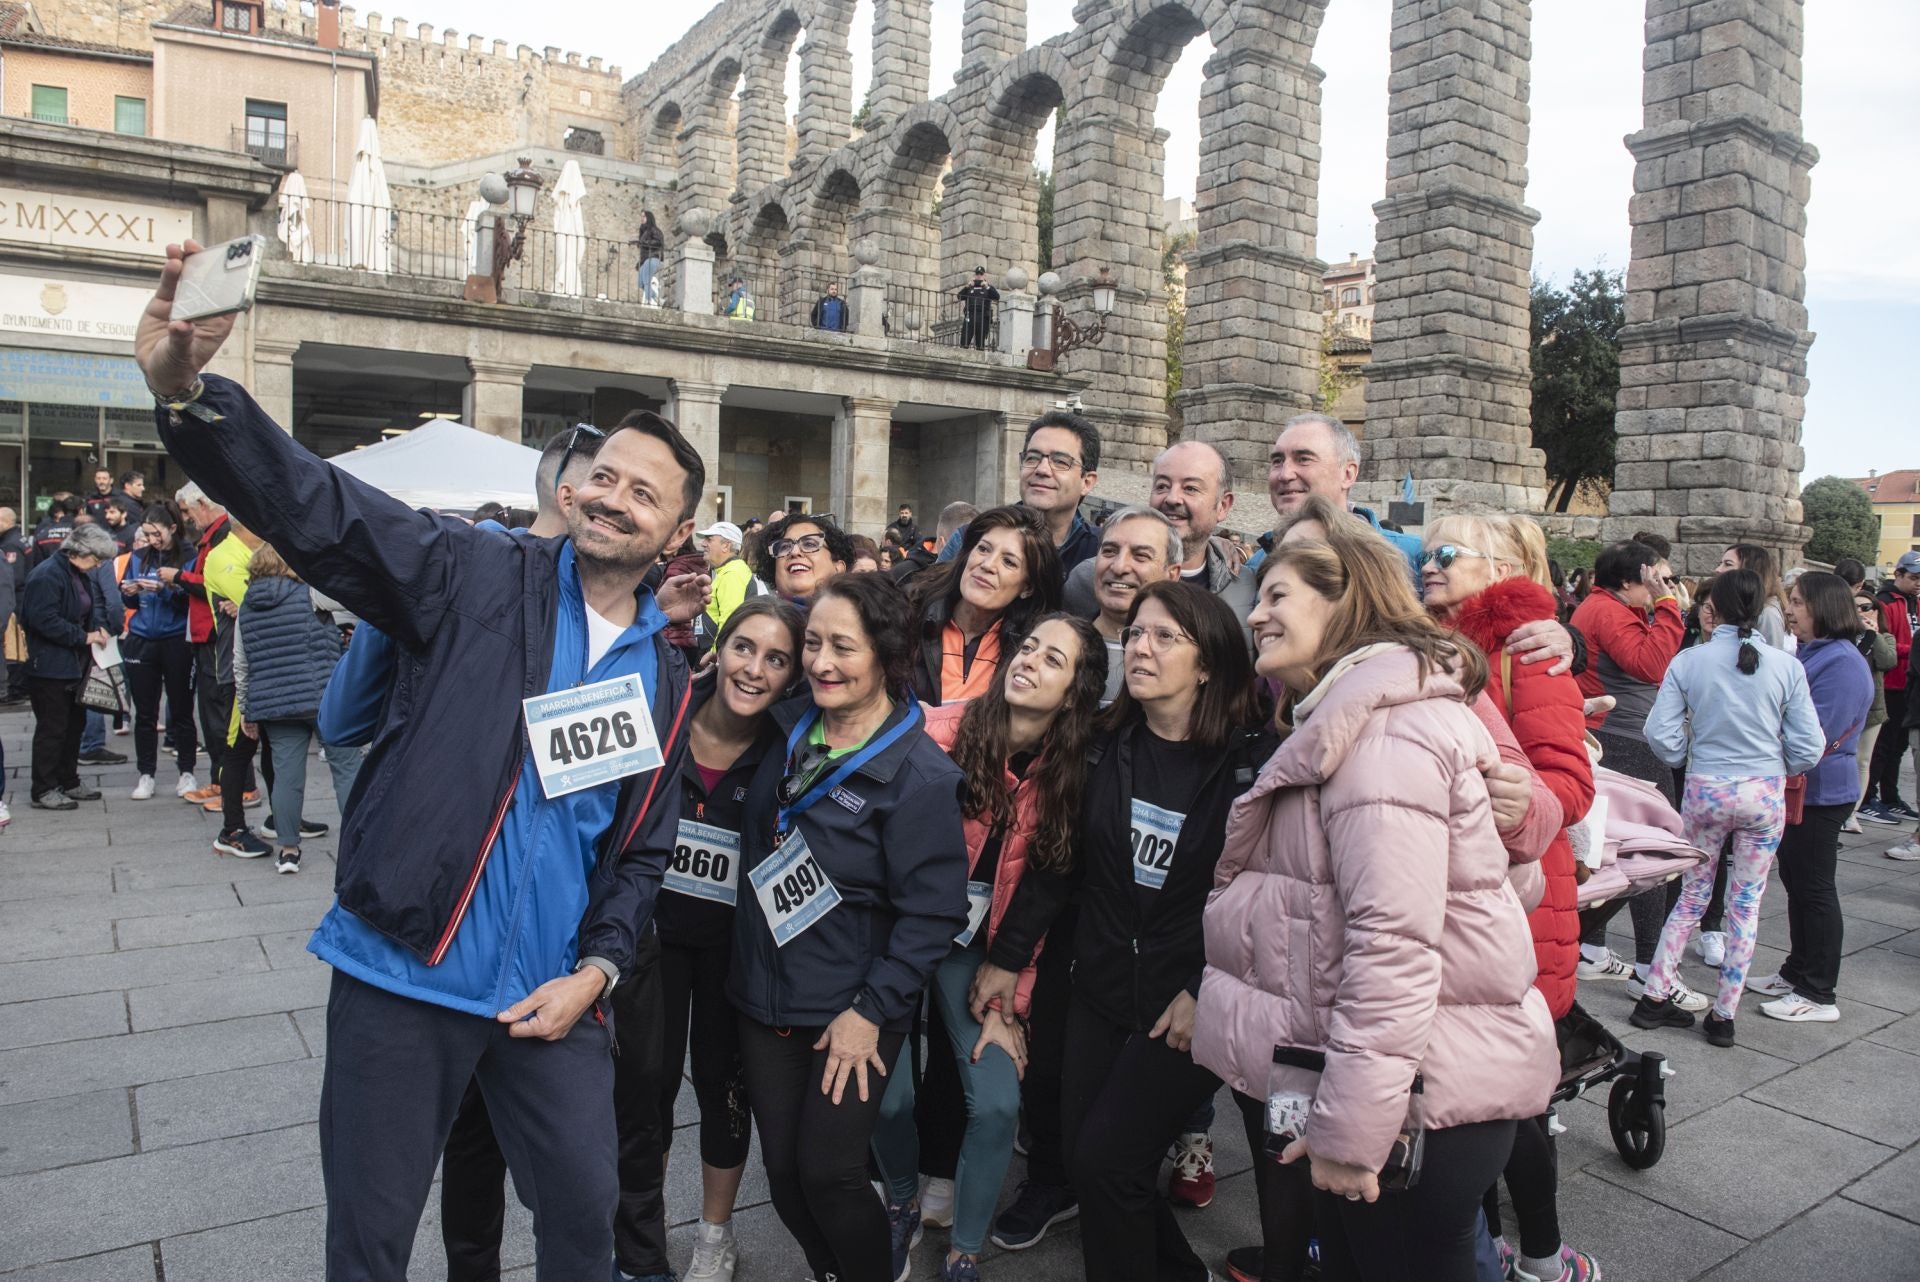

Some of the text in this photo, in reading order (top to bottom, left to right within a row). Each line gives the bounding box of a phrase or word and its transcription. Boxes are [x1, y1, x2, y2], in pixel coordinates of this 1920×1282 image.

[3, 314, 72, 331] AYUNTAMIENTO
[77, 320, 90, 332] DE
[80, 357, 93, 367] DE
[540, 685, 627, 712] MARCHA BENÉFICA
[551, 711, 637, 765] 4626
[673, 845, 729, 882] 860
[773, 856, 825, 915] 4997
